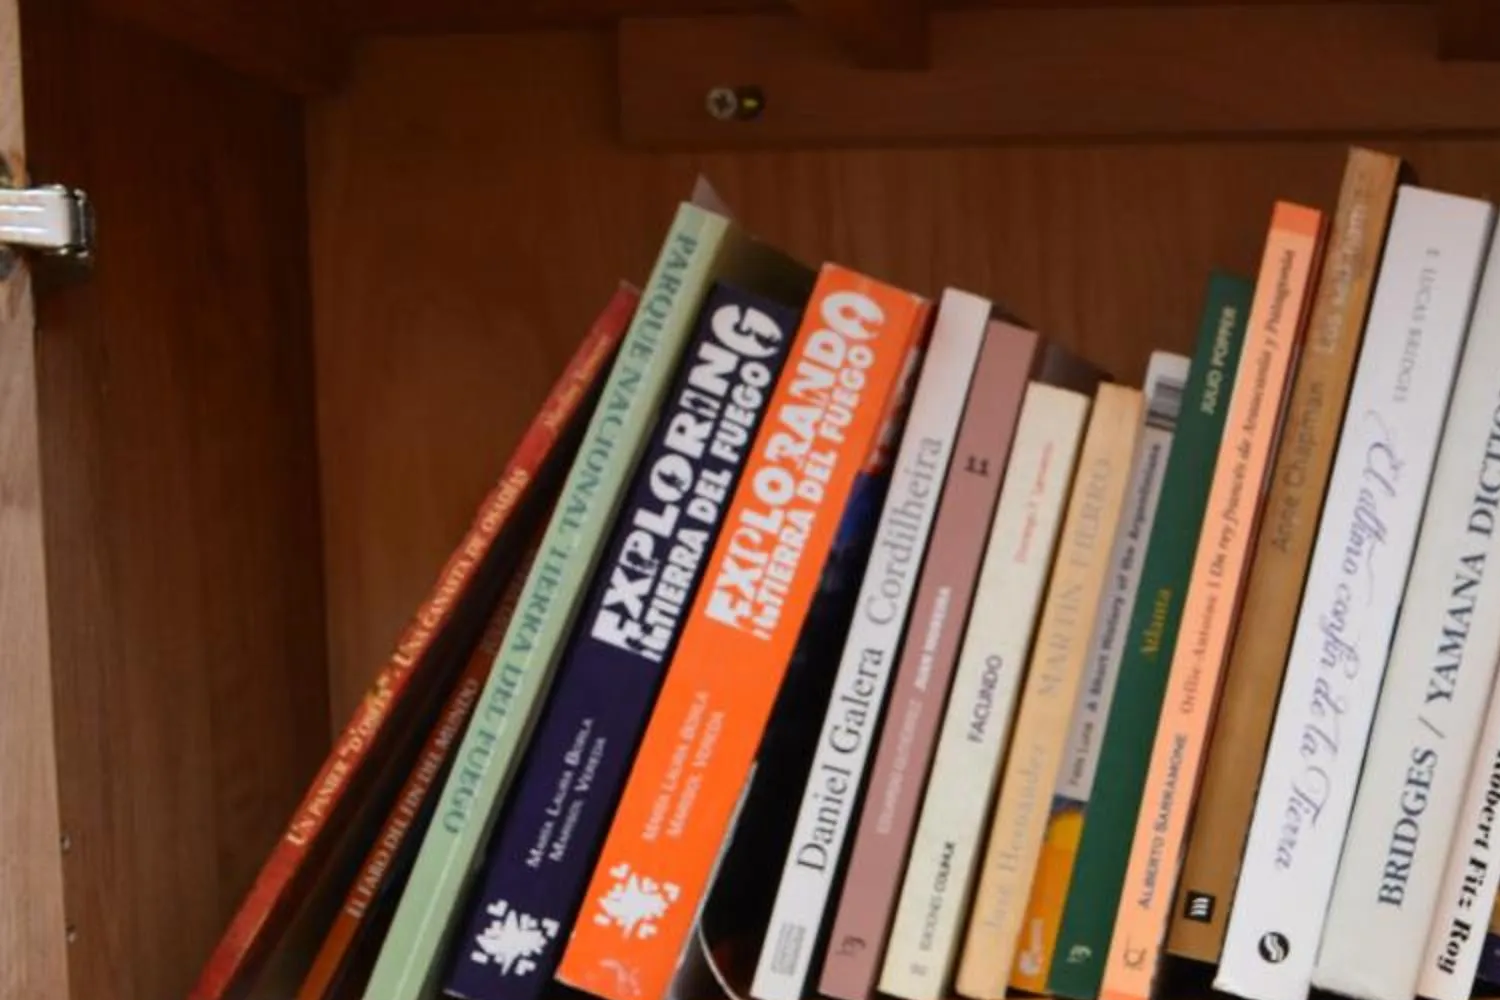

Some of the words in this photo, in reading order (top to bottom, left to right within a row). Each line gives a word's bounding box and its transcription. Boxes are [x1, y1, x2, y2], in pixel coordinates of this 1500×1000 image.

[627, 229, 698, 359] PARQUE
[556, 364, 645, 538] NACIONAL
[703, 285, 889, 631] EXPLORANDO
[706, 358, 775, 464] FUEGO
[589, 295, 789, 653] EXPLORING
[683, 461, 733, 524] DEL
[758, 505, 815, 606] TIERRA
[796, 444, 837, 504] DEL
[818, 340, 877, 445] FUEGO
[507, 541, 574, 661] TIERRA
[642, 521, 712, 629] TIERRA
[482, 661, 524, 724] DEL
[794, 761, 852, 873] Daniel
[826, 641, 885, 757] Galera
[861, 430, 943, 629] Cordilheira
[965, 652, 1004, 744] FACUNDO
[438, 726, 499, 836] FUEGO
[1375, 744, 1441, 909] BRIDGES
[1423, 548, 1488, 709] YAMANA
[1456, 856, 1488, 911] Fitz
[1435, 915, 1472, 976] Roy
